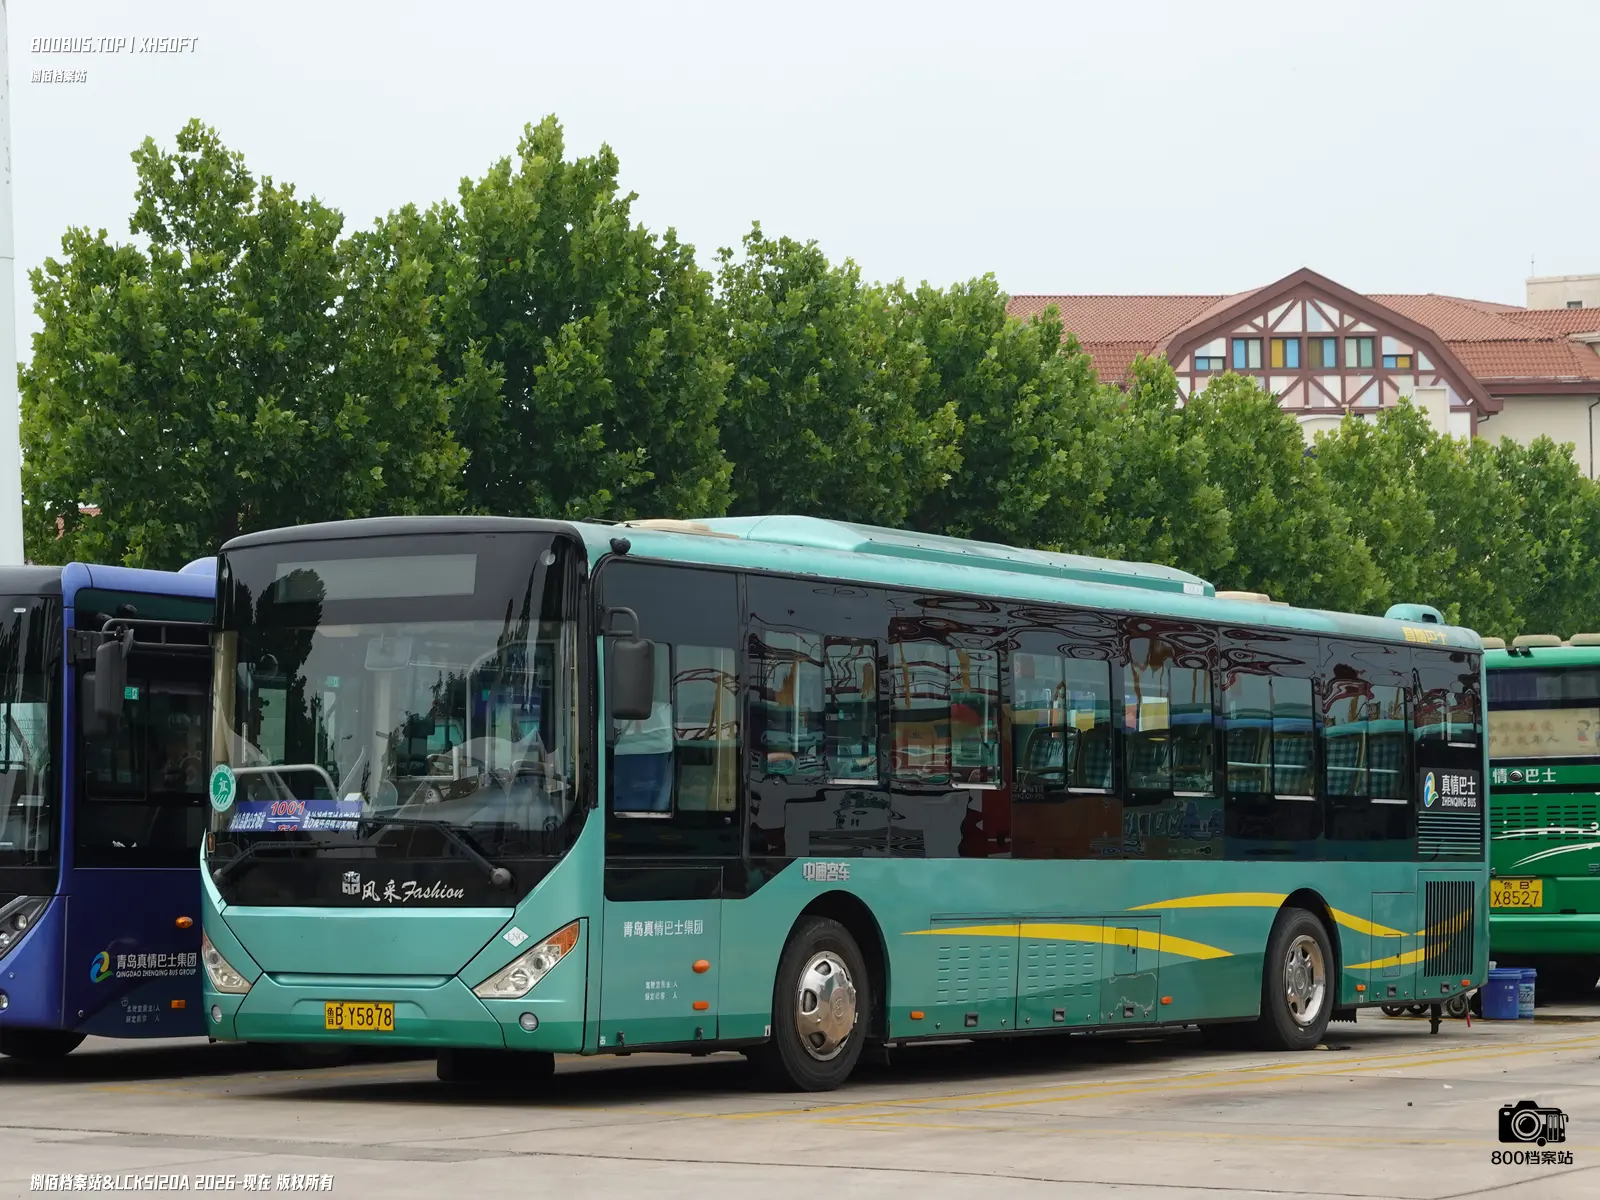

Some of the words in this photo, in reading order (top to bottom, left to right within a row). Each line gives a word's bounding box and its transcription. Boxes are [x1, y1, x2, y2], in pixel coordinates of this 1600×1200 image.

[1441, 774, 1477, 796] 真情巴士
[271, 800, 305, 816] 1001
[1467, 797, 1477, 808] BUS
[802, 862, 850, 882] 中通客车
[401, 881, 465, 902] Fashion
[1493, 890, 1540, 906] X8527
[623, 919, 704, 938] 青岛真情巴士集团
[507, 932, 526, 942] LNG
[117, 953, 197, 969] 青岛真情巴士集团
[116, 970, 142, 978] QINGDAO
